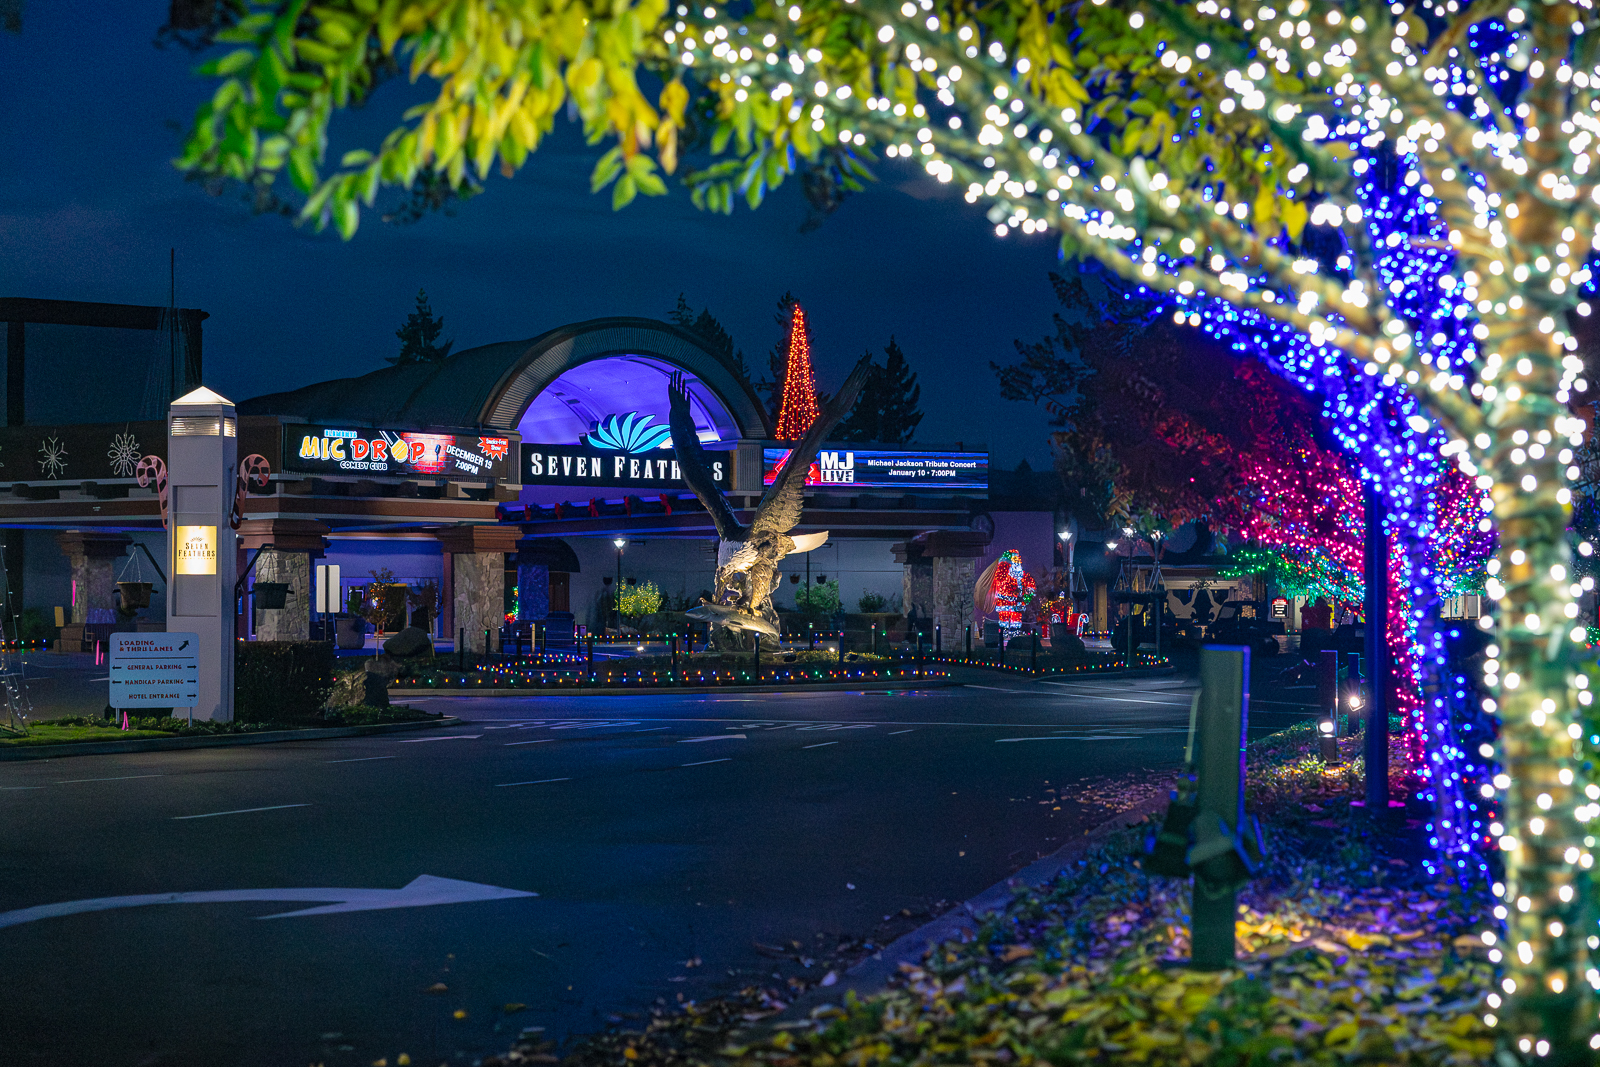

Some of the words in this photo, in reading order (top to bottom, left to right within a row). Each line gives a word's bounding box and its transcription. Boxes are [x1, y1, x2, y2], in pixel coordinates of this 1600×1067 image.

[324, 429, 358, 439] ELEMENTS
[299, 436, 346, 461] MIC
[446, 444, 484, 467] DECEMBER
[484, 459, 493, 470] 19
[820, 452, 854, 470] MJ
[867, 459, 893, 467] Michael
[895, 460, 923, 468] Jackson
[949, 461, 977, 469] Concert
[340, 461, 370, 470] COMEDY
[369, 461, 388, 471] CLUB
[455, 459, 479, 475] 7:00PM
[531, 452, 602, 477] SEVEN
[613, 456, 723, 481] FEATHS
[888, 469, 916, 477] January
[821, 469, 854, 483] LIVE
[178, 549, 215, 557] FEATHERS
